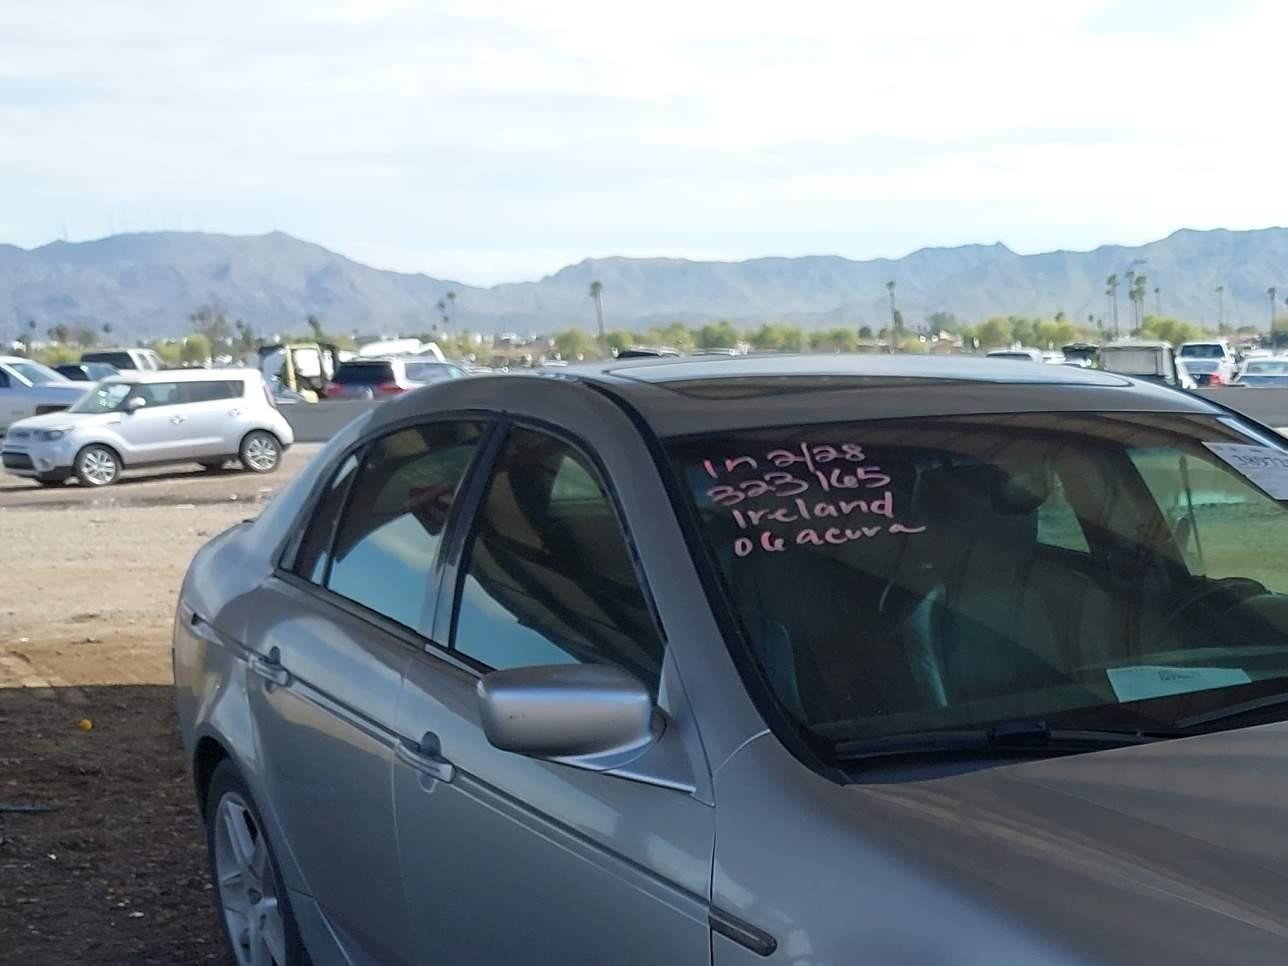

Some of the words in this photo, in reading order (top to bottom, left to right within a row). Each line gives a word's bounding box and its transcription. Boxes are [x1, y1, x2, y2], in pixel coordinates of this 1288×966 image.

[767, 442, 866, 473] 2/28
[732, 491, 894, 529] Ireland
[735, 532, 786, 557] 06
